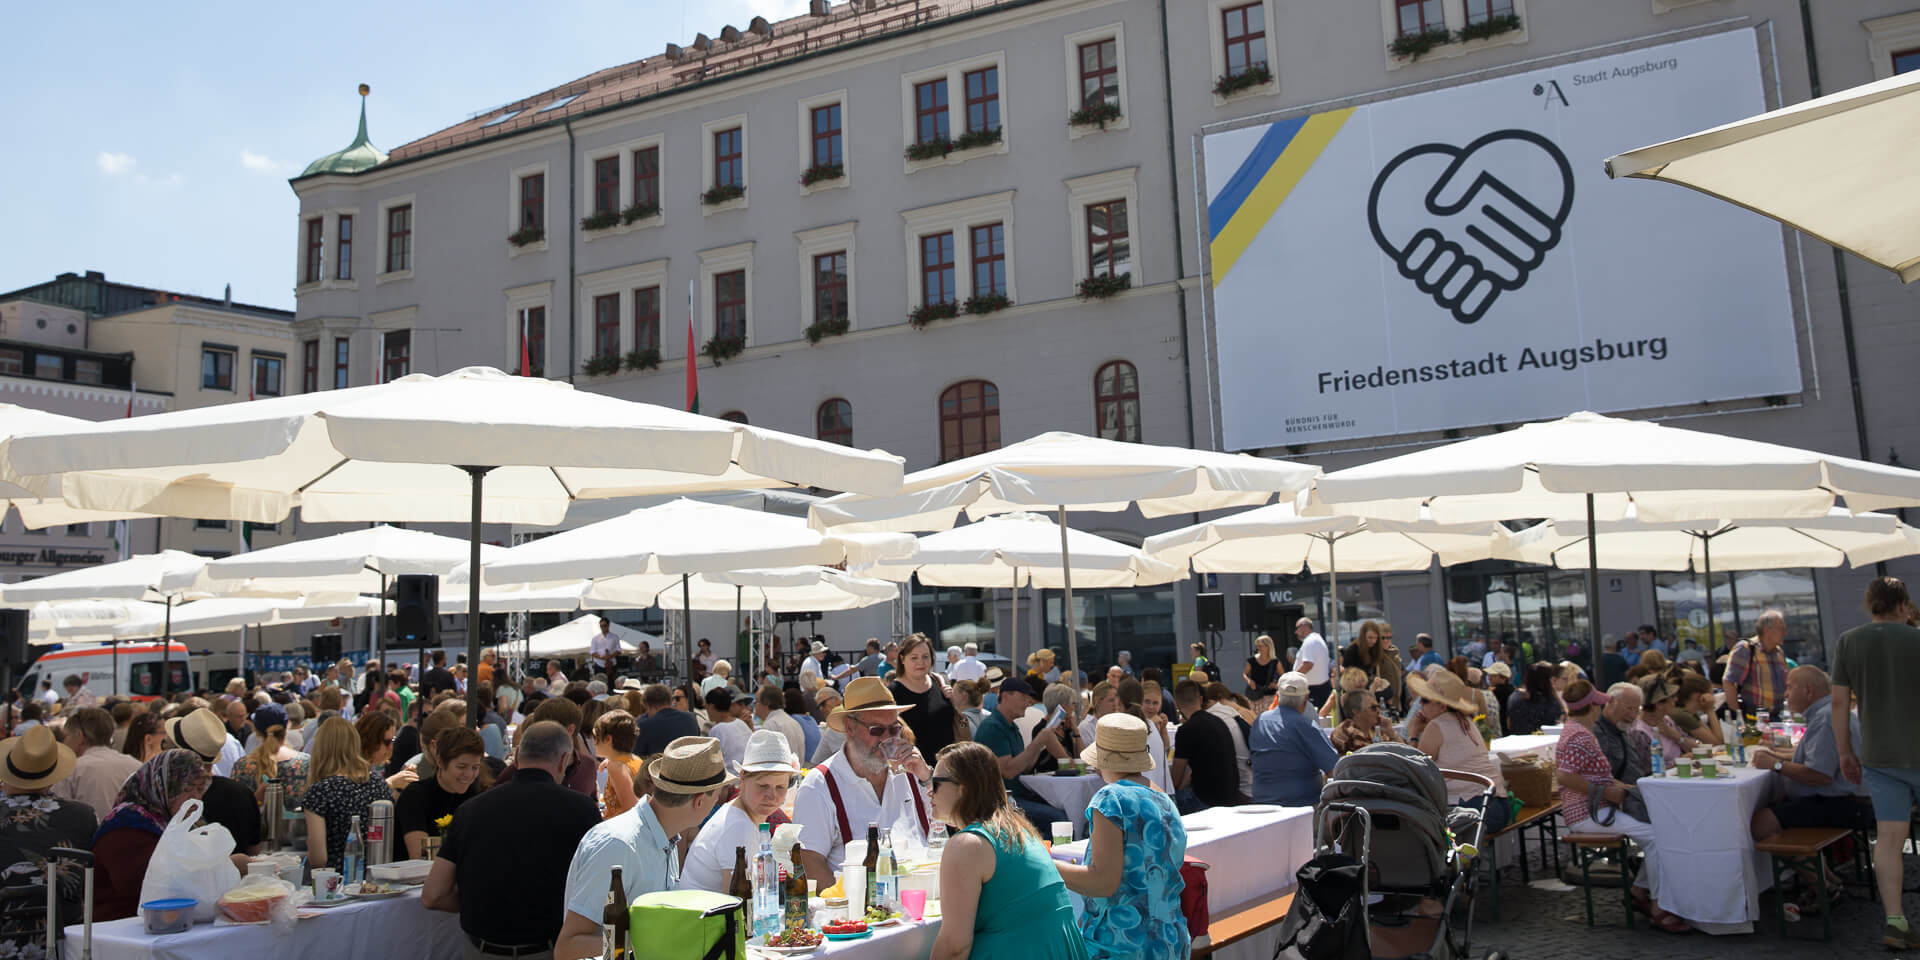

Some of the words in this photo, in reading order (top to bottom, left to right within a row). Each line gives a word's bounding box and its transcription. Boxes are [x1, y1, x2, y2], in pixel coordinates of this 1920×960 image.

[1573, 71, 1607, 86] Stadt
[1612, 58, 1678, 77] Augsburg
[1318, 352, 1508, 394] Friedensstadt
[1517, 336, 1668, 371] Augsburg
[1270, 590, 1292, 602] WC
